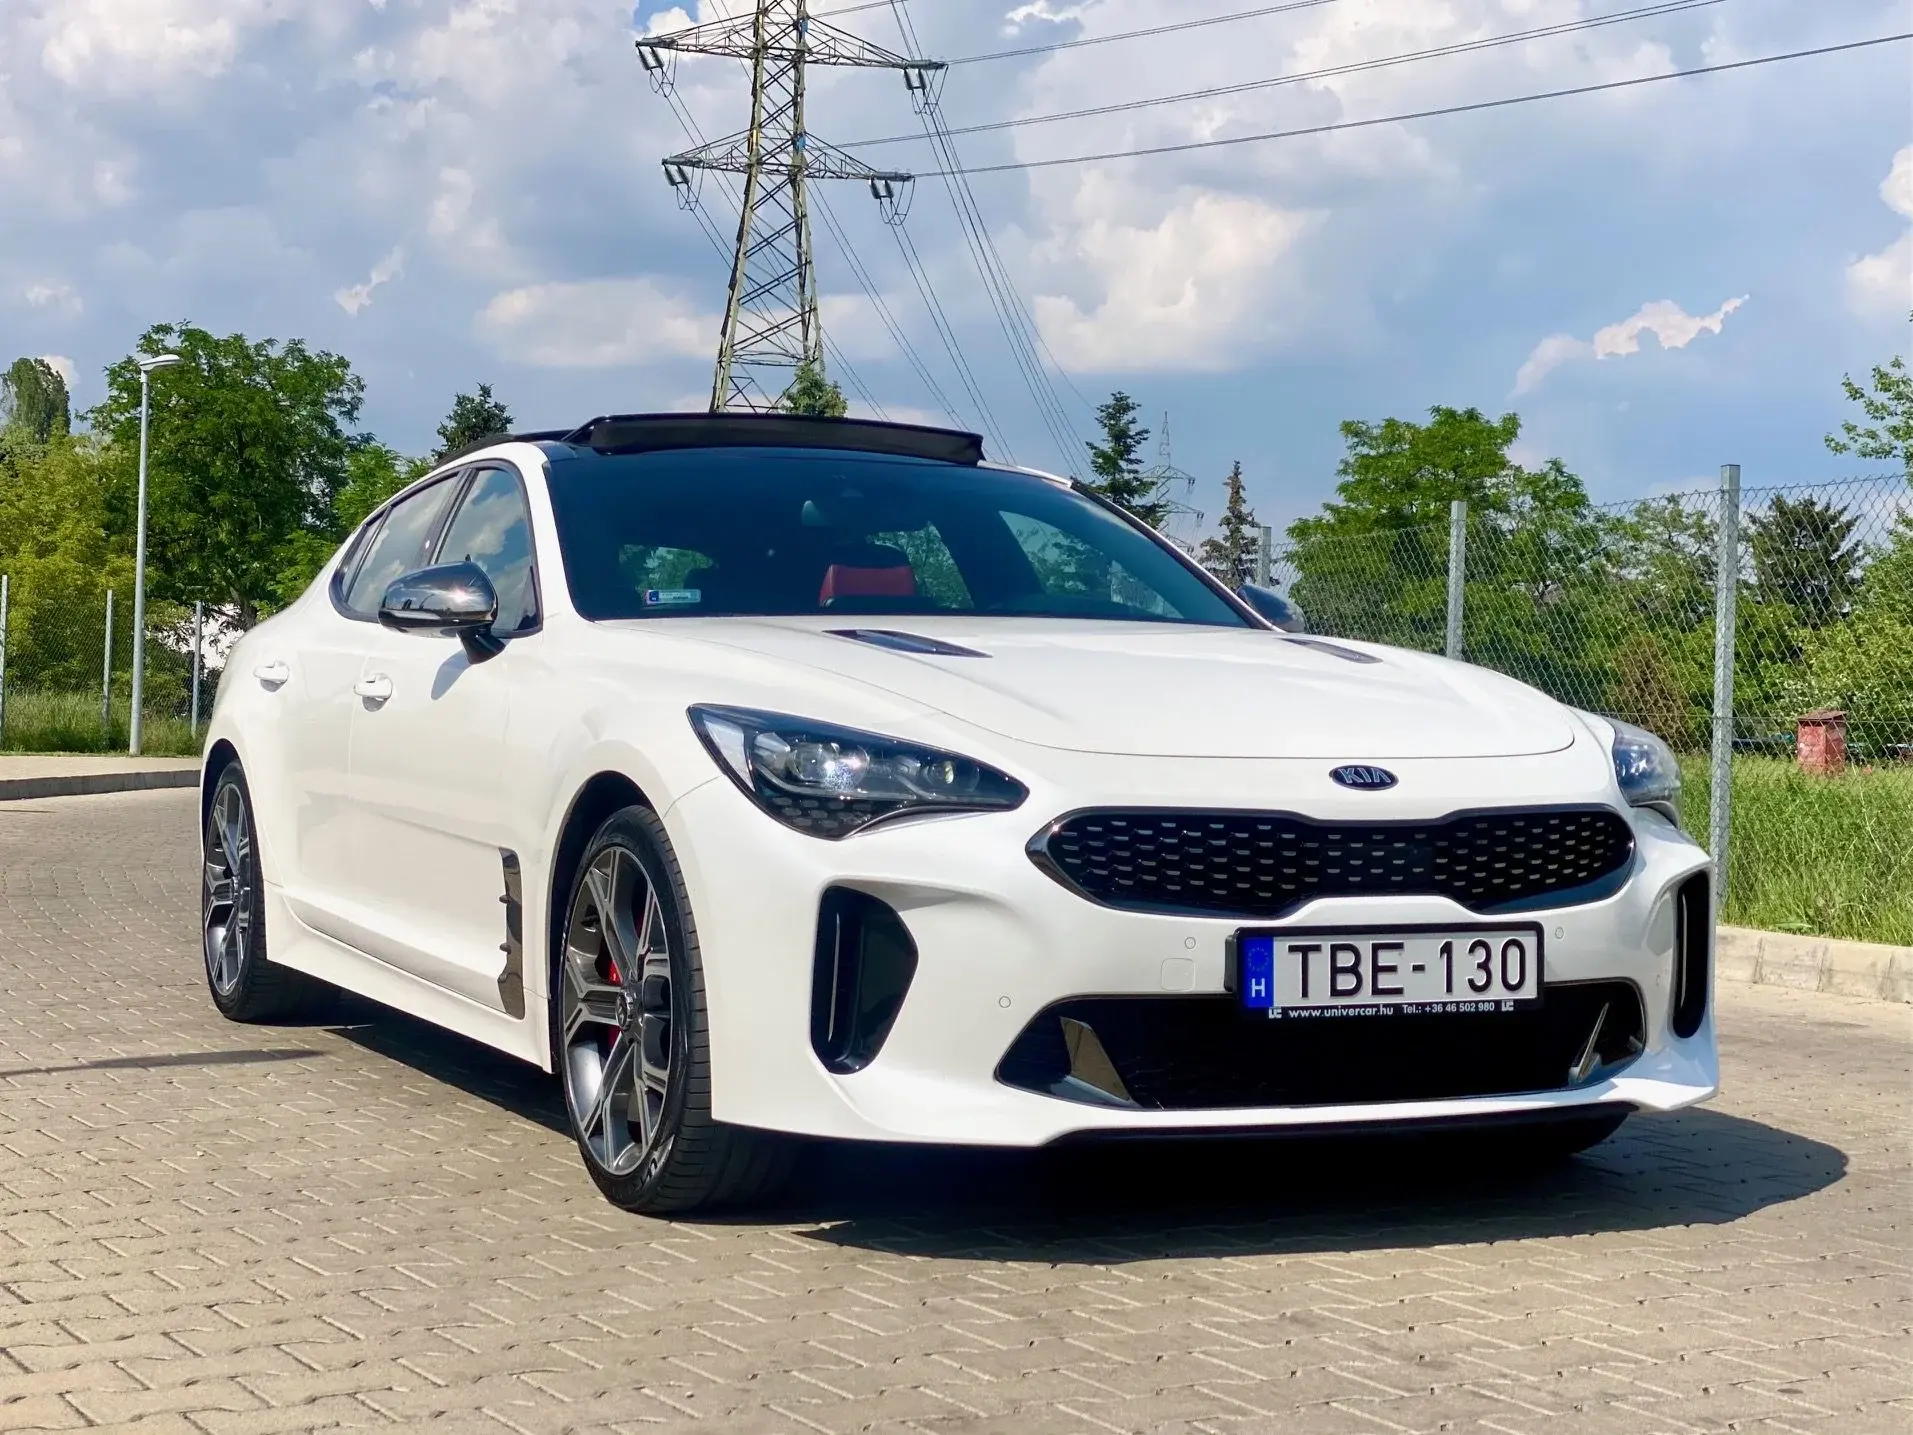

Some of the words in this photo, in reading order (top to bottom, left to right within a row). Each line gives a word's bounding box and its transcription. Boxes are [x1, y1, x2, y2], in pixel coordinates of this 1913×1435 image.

[1338, 767, 1391, 783] KIA
[1287, 938, 1526, 999] TBE-130
[1251, 978, 1265, 998] H
[1288, 1004, 1394, 1017] www.univercar.hu
[1402, 1004, 1422, 1014] Tel.:
[1424, 1003, 1443, 1013] +36
[1445, 1003, 1457, 1012] 46
[1459, 1002, 1476, 1012] 502
[1478, 1002, 1495, 1011] 980
